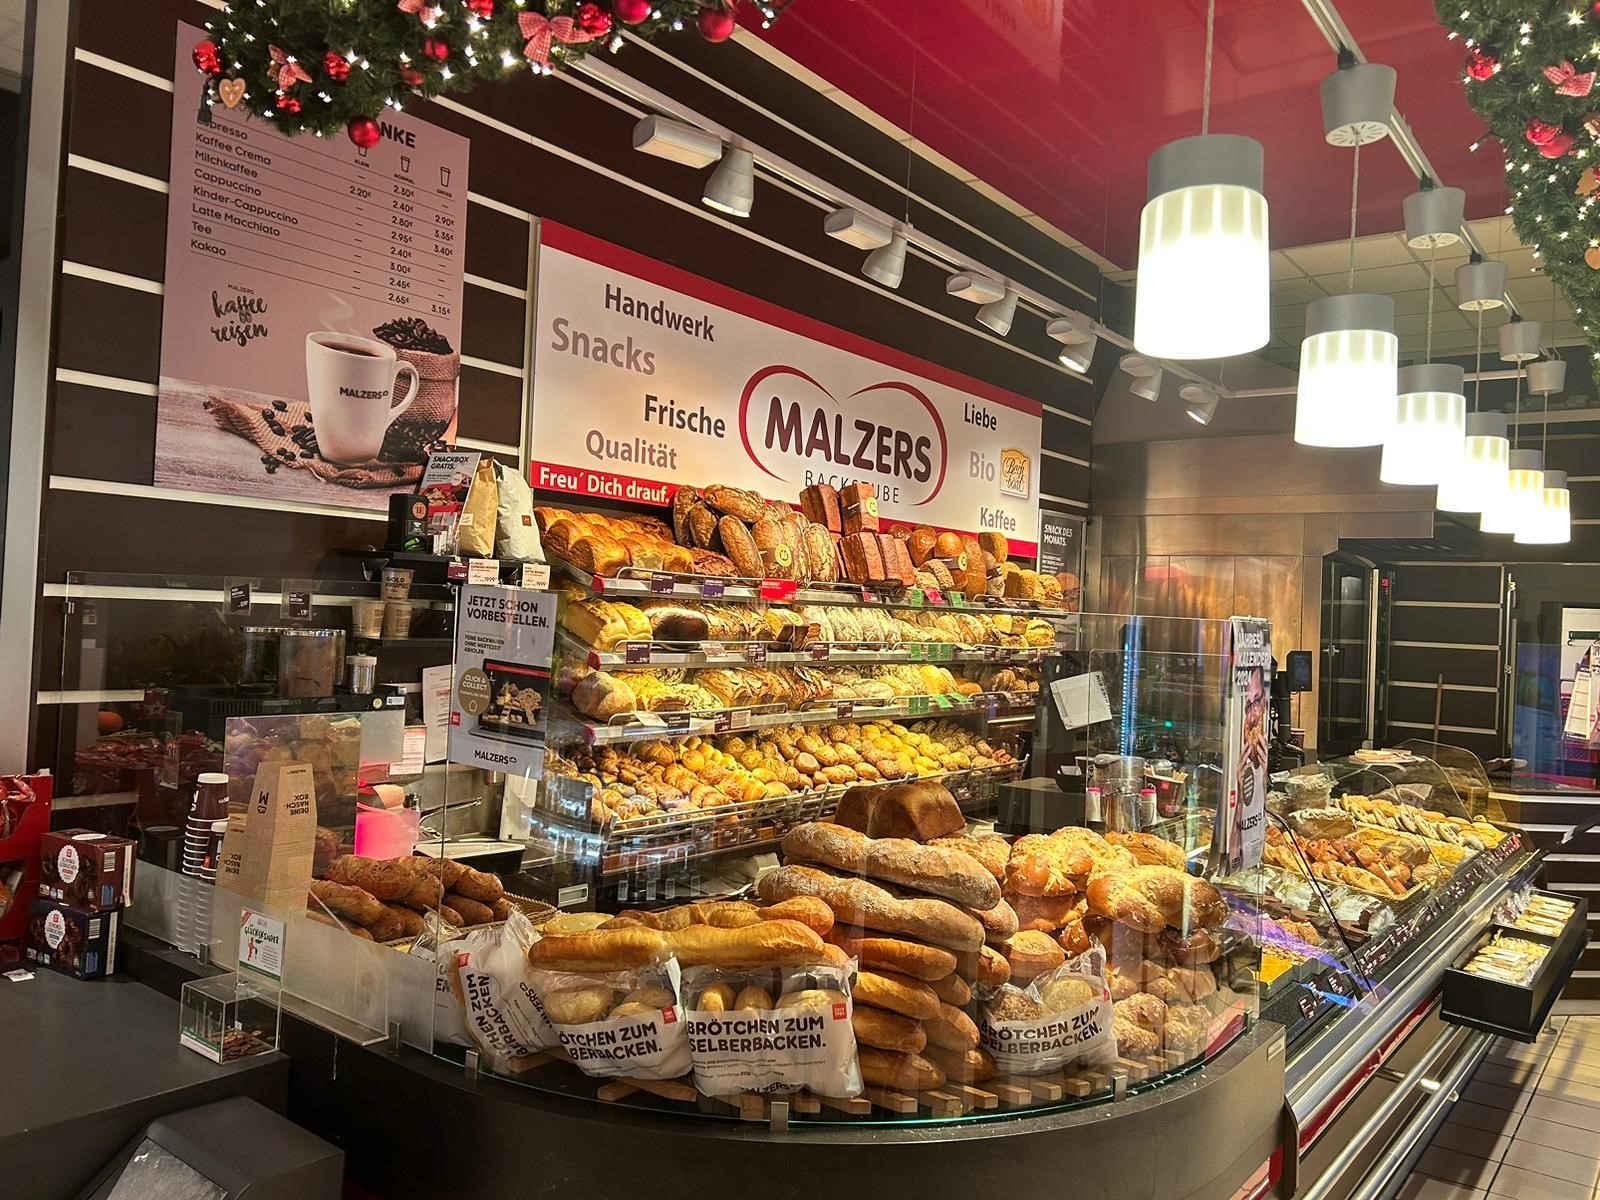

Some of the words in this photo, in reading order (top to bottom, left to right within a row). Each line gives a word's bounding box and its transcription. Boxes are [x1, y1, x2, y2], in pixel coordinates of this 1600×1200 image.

[195, 132, 232, 152] Kaffee
[235, 146, 271, 165] Crema
[194, 150, 258, 178] Milchkaffee
[194, 168, 262, 196] Cappuccino
[193, 184, 298, 225] Kinder-Cappuccino
[191, 220, 212, 235] Tee
[192, 202, 222, 219] Latte
[224, 213, 280, 236] Macchiato
[190, 239, 227, 256] Kakao
[211, 290, 268, 323] kaffee
[604, 283, 715, 342] Handwerk
[551, 316, 656, 376] Snacks
[339, 386, 383, 400] MALZERS
[644, 393, 726, 438] Frische
[964, 402, 997, 431] Liebe
[585, 429, 677, 470] Qualität
[764, 396, 932, 483] MALZERS
[433, 455, 470, 463] SNACKBOX
[969, 451, 995, 482] Bio
[587, 473, 622, 496] Dich
[626, 478, 670, 503] drauf.
[980, 506, 1016, 531] Kaffee
[467, 595, 497, 608] JETZT
[499, 598, 538, 613] SCHON
[467, 607, 549, 628] VORBESTELLEN.
[462, 680, 488, 691] COLLECT
[464, 673, 481, 683] CLICK
[474, 749, 509, 765] MALZERS
[619, 1021, 657, 1042] ZUM
[687, 1016, 779, 1037] BRÖTCHEN
[784, 1015, 824, 1032] ZUM
[1071, 1006, 1099, 1031] ZUM
[689, 1034, 827, 1053] SELBERBACKEN.
